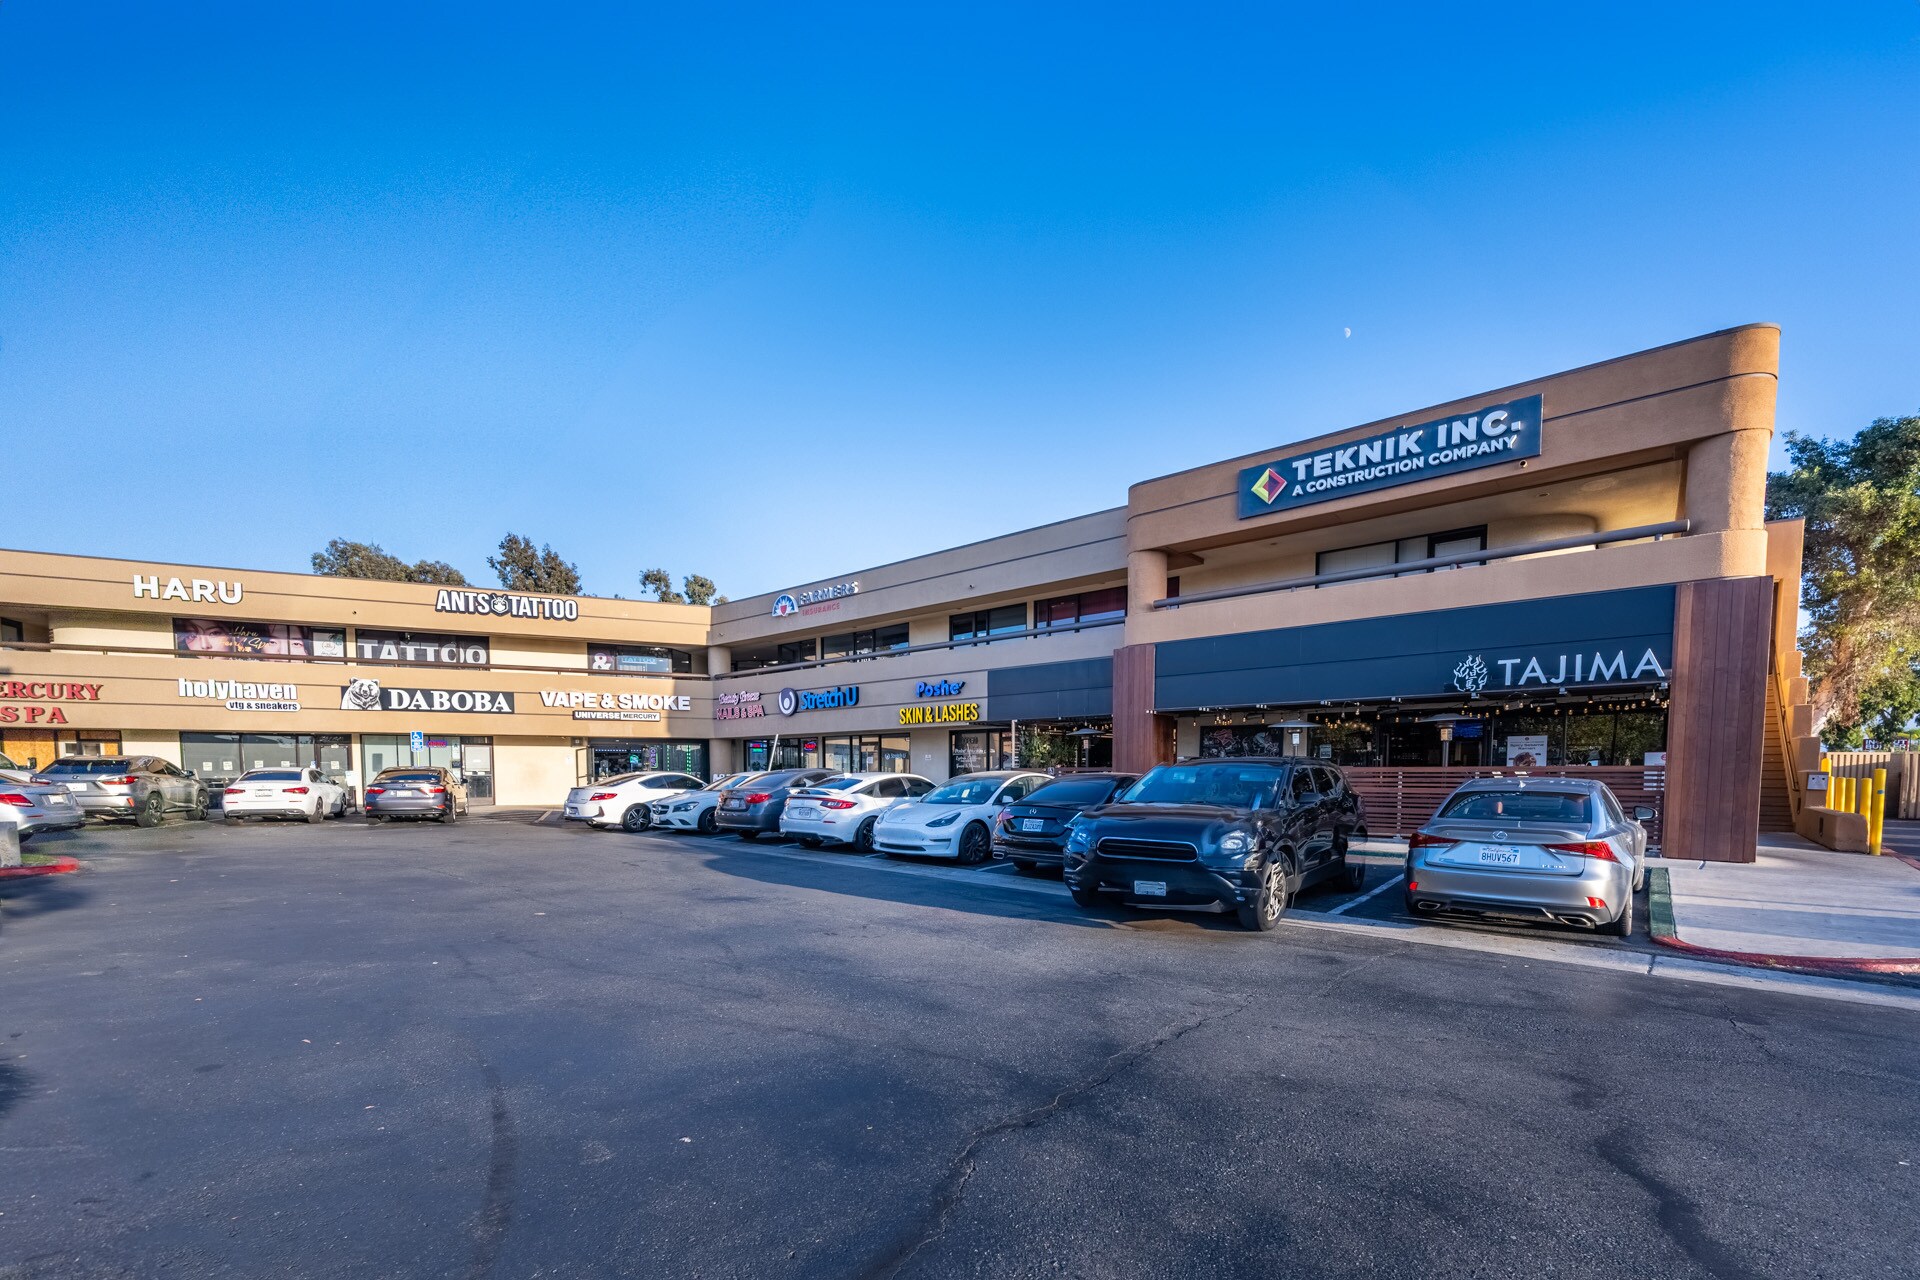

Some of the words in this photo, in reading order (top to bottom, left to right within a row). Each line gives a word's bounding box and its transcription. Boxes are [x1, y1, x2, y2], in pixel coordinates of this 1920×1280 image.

[1292, 430, 1423, 480] TEKNIK
[1437, 410, 1521, 449] INC.
[1292, 484, 1304, 497] A
[1306, 456, 1425, 492] CONSTRUCTION
[1429, 435, 1518, 465] COMPANY
[133, 574, 243, 604] HARU
[800, 582, 860, 605] FARMERS
[436, 590, 490, 614] ANTS
[508, 595, 578, 619] TATTOO
[802, 602, 841, 616] INSURANCE
[357, 639, 487, 665] TATTOO
[1498, 648, 1665, 686] TAJIMA
[178, 678, 298, 700] holyhaven
[800, 687, 844, 710] Stretch
[845, 685, 858, 706] U
[229, 701, 244, 710] vtg
[255, 701, 298, 710] sneakers
[388, 689, 512, 713] DABOBA
[540, 691, 598, 709] VAPE
[601, 693, 615, 709] &
[618, 694, 691, 711] SMOKE
[716, 706, 741, 720] NAILS
[747, 704, 765, 718] SPA
[0, 706, 68, 724] SPA
[575, 711, 621, 720] UNIVERSE
[622, 712, 658, 720] MERCURY
[899, 707, 924, 725] SKIN
[925, 706, 933, 723] &
[935, 703, 978, 722] LASHES
[1481, 851, 1518, 863] 8HUV567
